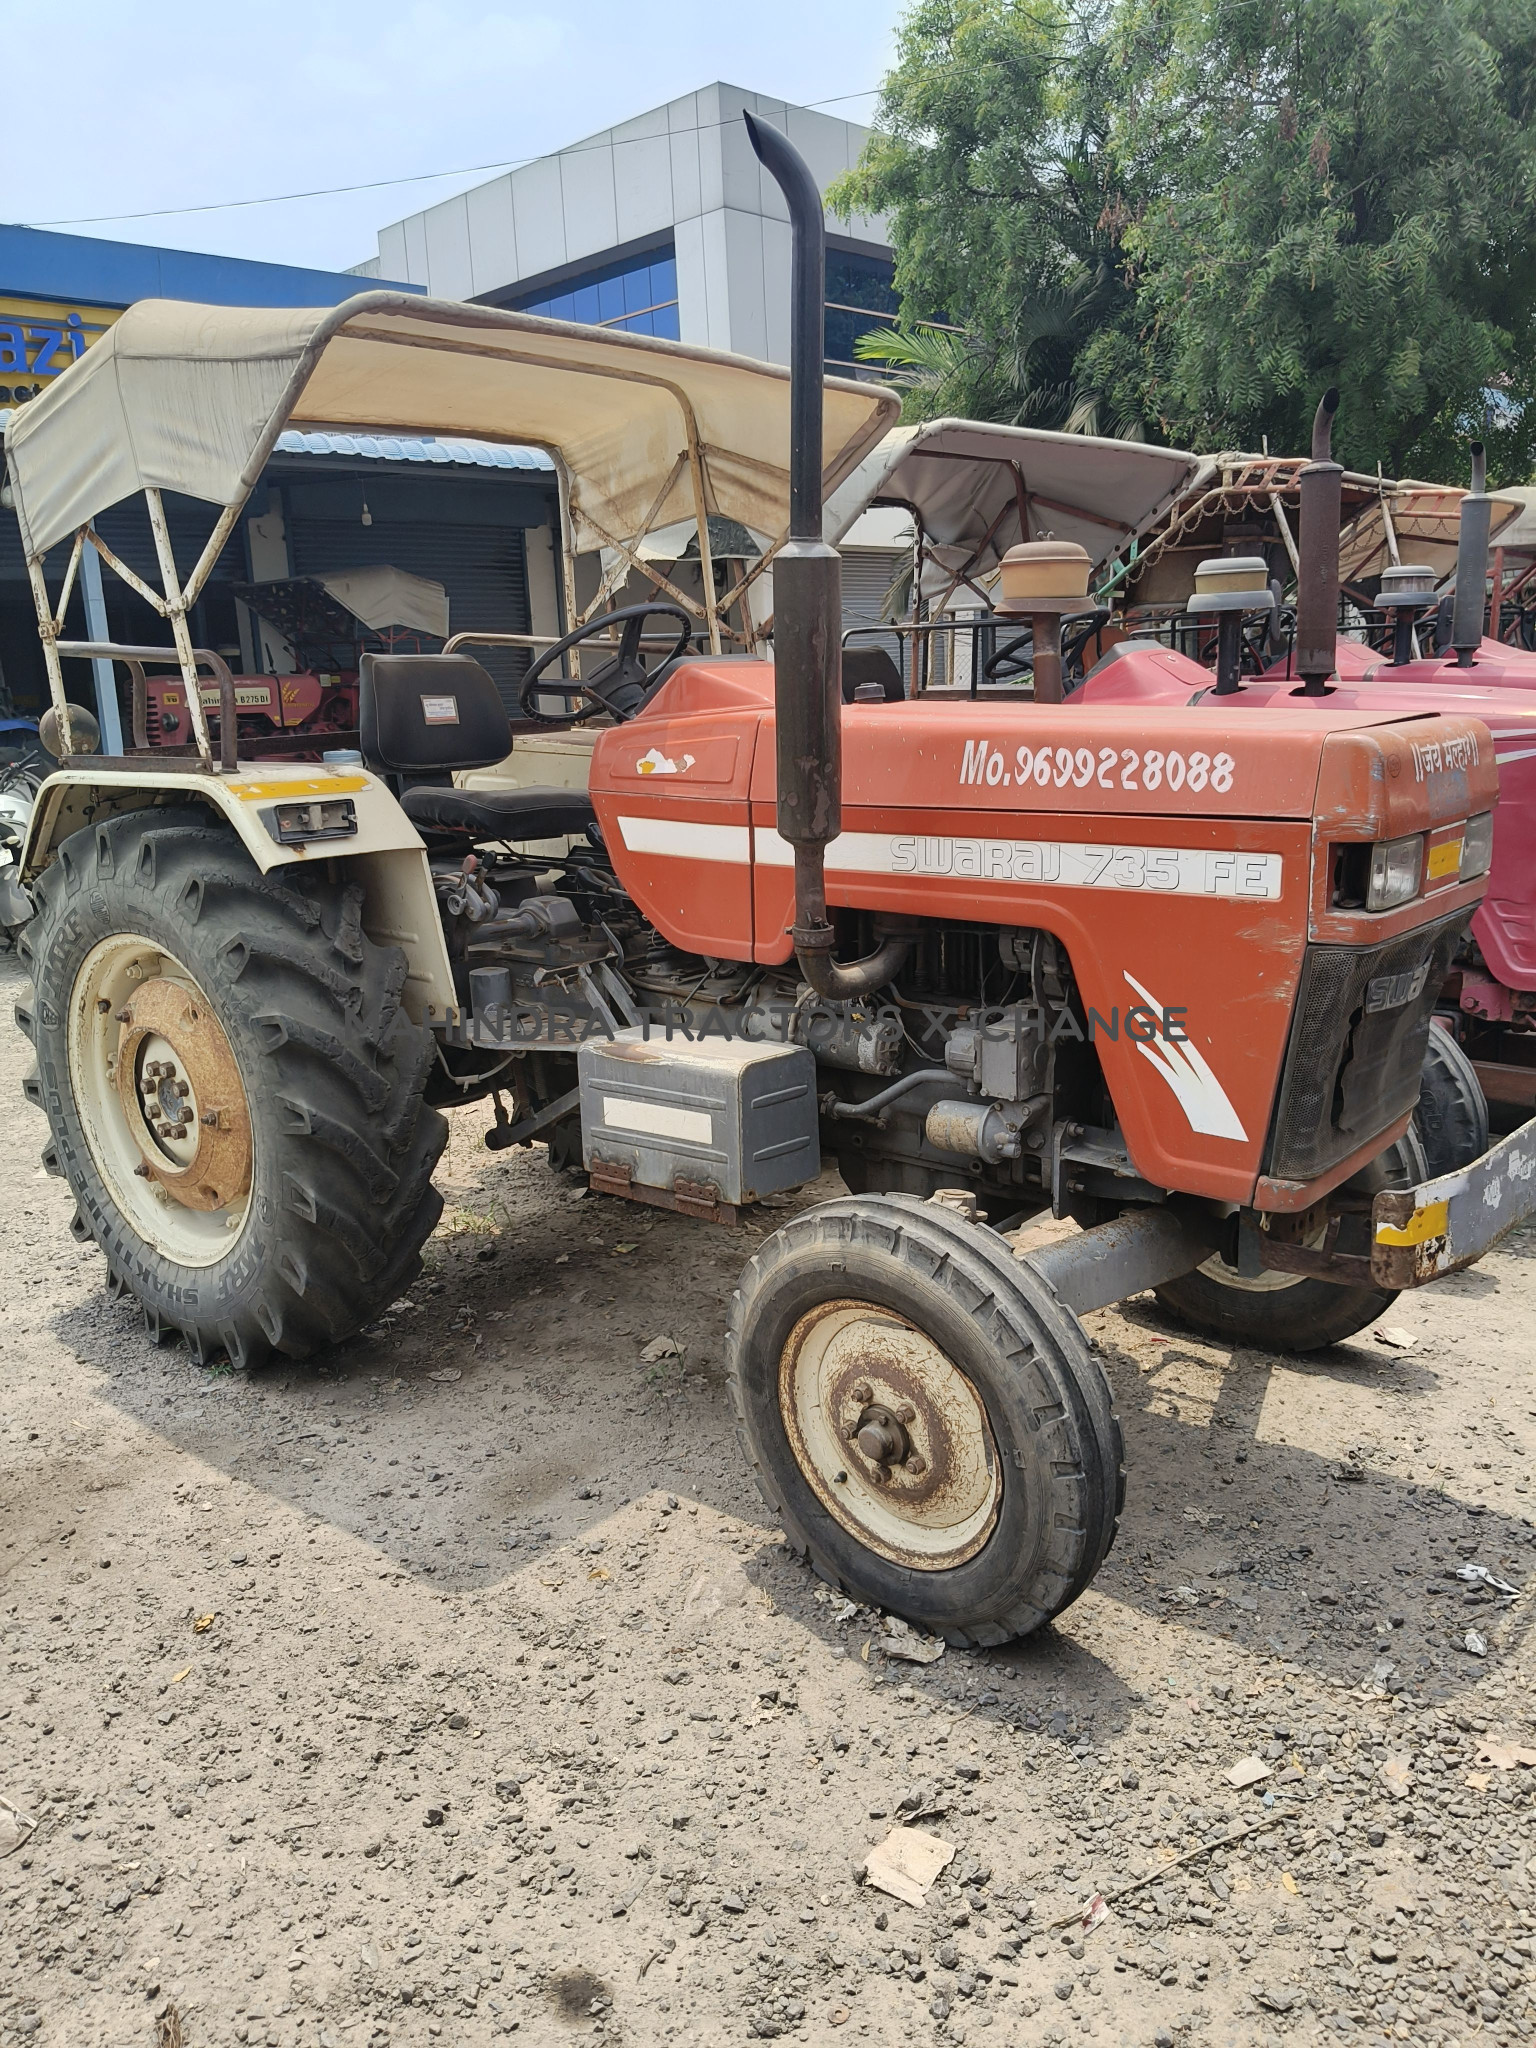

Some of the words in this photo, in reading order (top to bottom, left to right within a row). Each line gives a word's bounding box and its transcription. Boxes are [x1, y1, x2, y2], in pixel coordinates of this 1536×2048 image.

[1082, 846, 1180, 890] 735
[1203, 851, 1268, 897] FE
[43, 903, 85, 1002] MRF
[44, 1061, 77, 1163] PLUS
[73, 1169, 113, 1240] LIFE
[114, 1236, 201, 1306] SHAKTI
[215, 1228, 266, 1306] MRF
